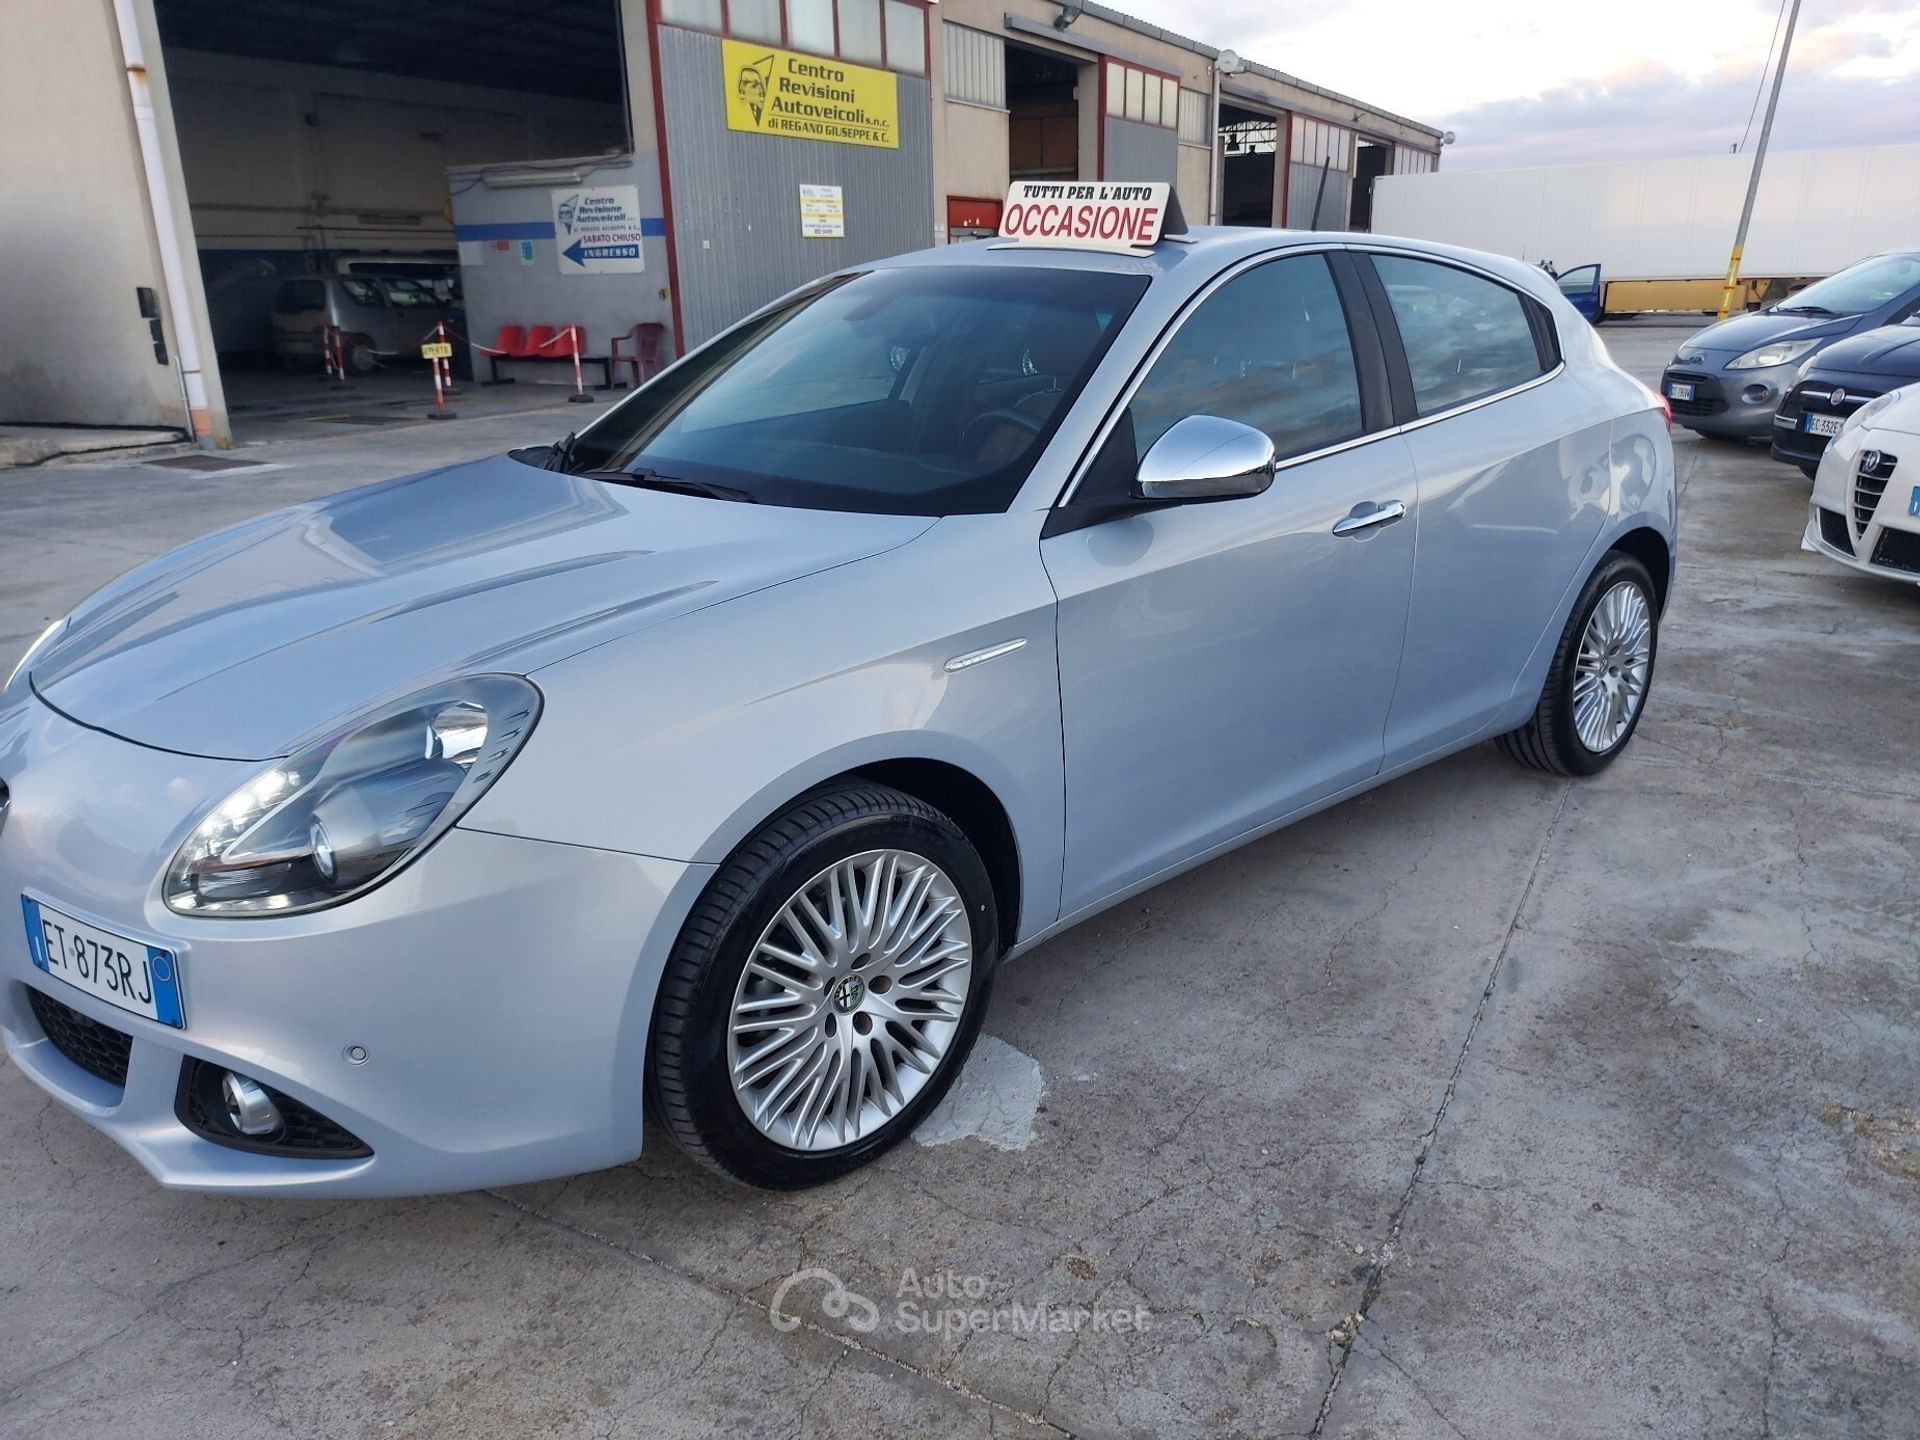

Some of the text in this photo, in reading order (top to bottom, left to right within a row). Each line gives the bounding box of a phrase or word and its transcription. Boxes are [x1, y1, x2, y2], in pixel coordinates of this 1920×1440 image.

[788, 58, 844, 82] Centro
[779, 77, 855, 103] Revisioni
[771, 96, 864, 124] Autoveicoli
[768, 118, 890, 143] di REGANO GIUSEPPE & C.
[1023, 185, 1153, 201] TUTTI PER L'AUTO
[1005, 203, 1159, 241] OCCASIONE
[583, 233, 641, 244] SABATO CHIUSO
[584, 247, 636, 258] INGRESSO
